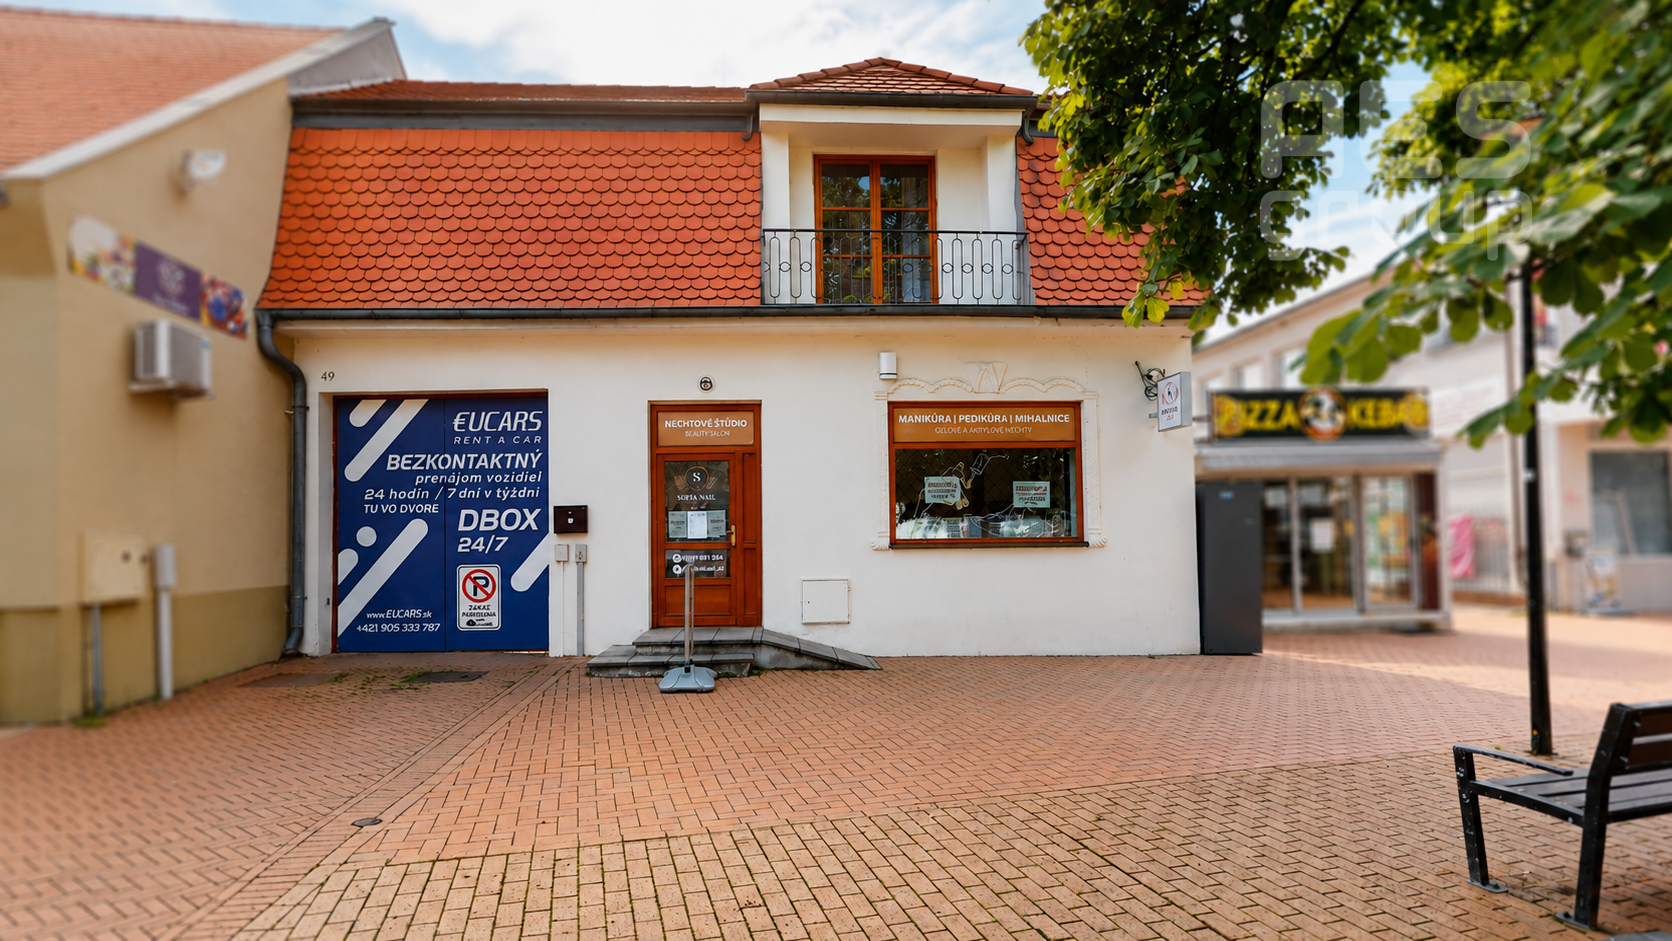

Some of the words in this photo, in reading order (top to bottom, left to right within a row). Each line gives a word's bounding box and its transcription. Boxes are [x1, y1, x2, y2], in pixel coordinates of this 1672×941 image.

[320, 371, 335, 382] 49
[664, 418, 713, 428] NECHTOVÉ
[714, 417, 748, 428] ŠTÚDIO
[1015, 414, 1070, 423] MIHALNICE
[453, 436, 491, 445] RENT
[497, 436, 505, 444] A
[512, 435, 542, 444] CAR
[386, 448, 543, 471] BEZKONTAKTNÝ
[415, 472, 482, 486] prenájom
[487, 471, 542, 483] vozidiel
[692, 472, 701, 482] S
[364, 488, 385, 500] 24
[447, 487, 456, 499] 7
[484, 489, 492, 498] v
[496, 486, 540, 501] týždni
[364, 504, 378, 514] TU
[381, 504, 397, 514] VO
[400, 504, 439, 513] DVORE
[458, 508, 541, 531] DBOX
[457, 534, 509, 554] 24/7
[366, 608, 432, 619] www.EUCARS.sk
[356, 623, 378, 632] +421
[380, 623, 400, 632] 905
[401, 623, 420, 632] 333
[422, 623, 441, 632] 787
